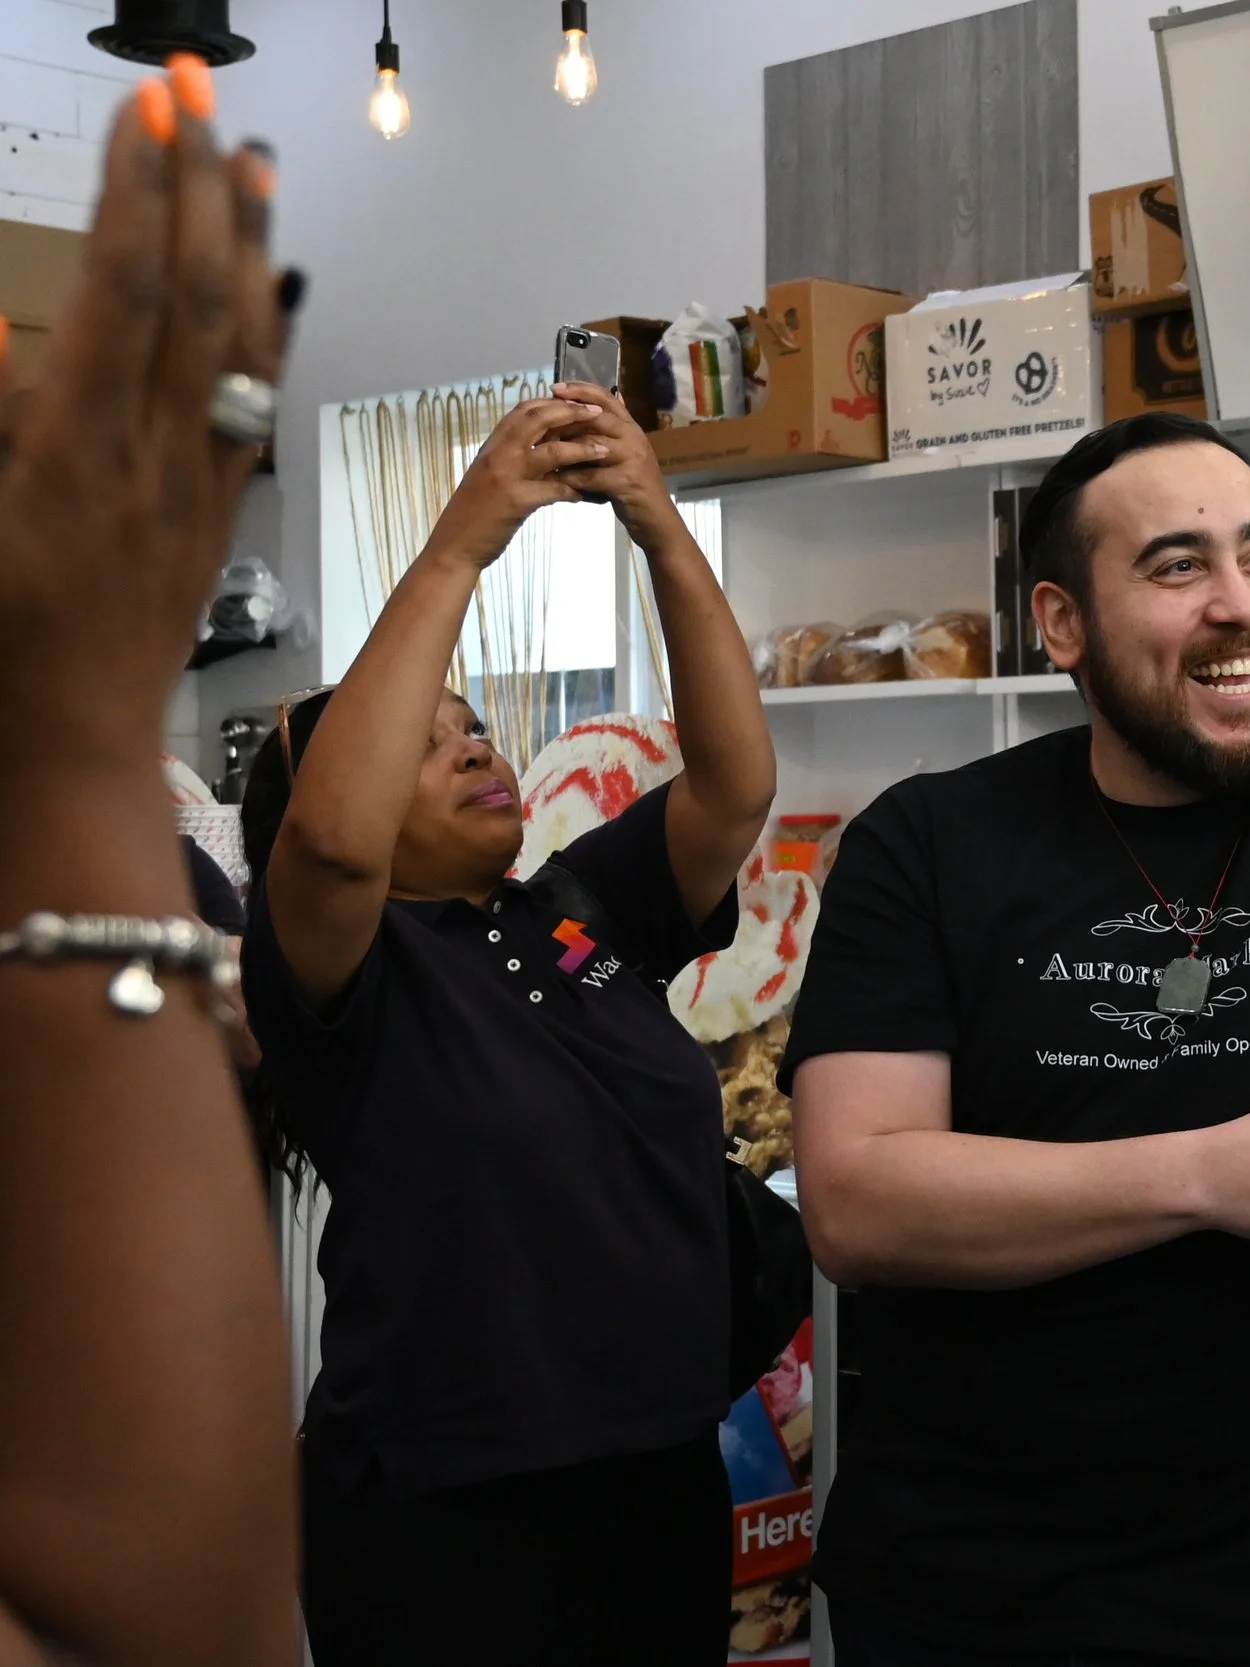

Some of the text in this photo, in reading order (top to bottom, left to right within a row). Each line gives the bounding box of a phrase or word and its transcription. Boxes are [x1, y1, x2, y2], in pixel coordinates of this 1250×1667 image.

[927, 358, 992, 384] SAVOR
[930, 389, 944, 406] by
[916, 436, 946, 449] GRAIN
[948, 432, 969, 444] AND
[971, 428, 1007, 442] GLUTEN
[1009, 425, 1032, 437] FREE
[1039, 952, 1165, 987] Aurora
[1036, 1050, 1099, 1067] Veteran
[1103, 1053, 1159, 1070] Owned
